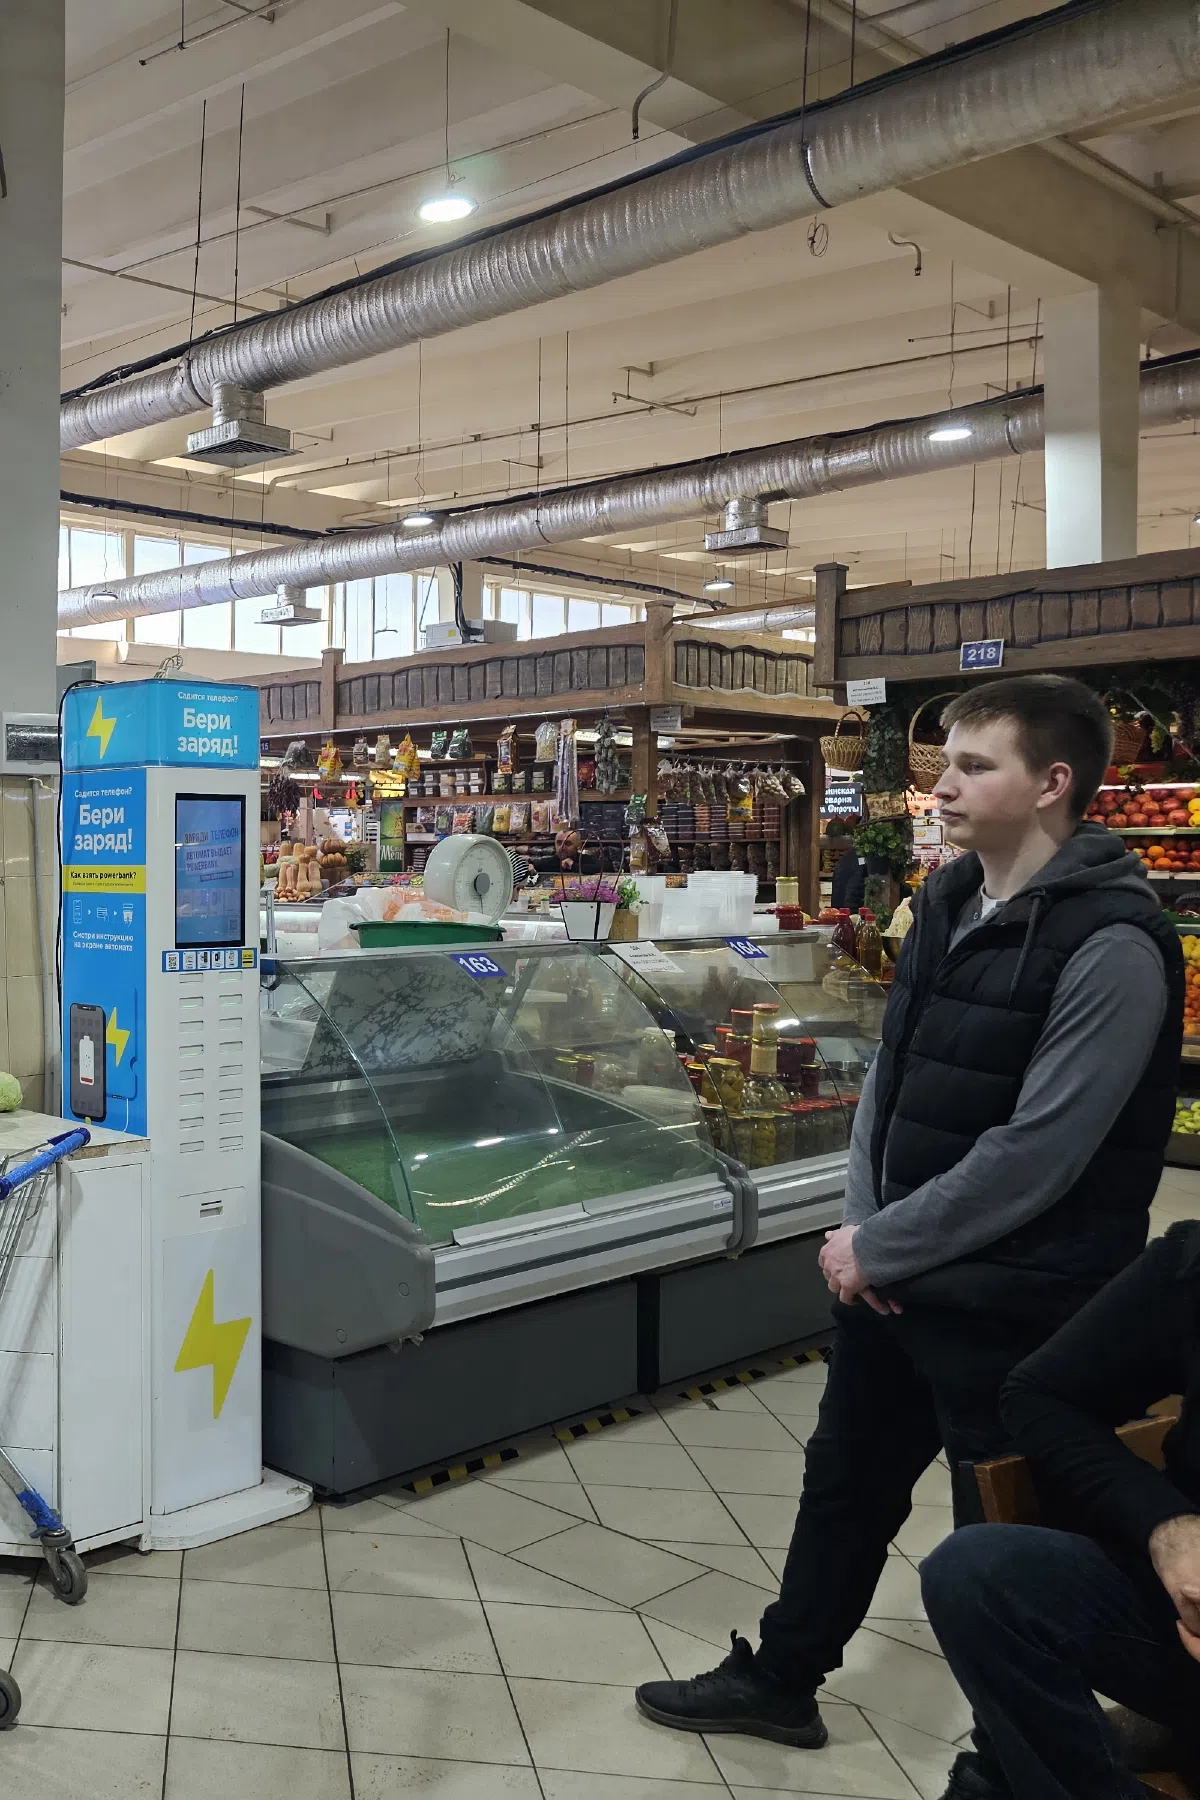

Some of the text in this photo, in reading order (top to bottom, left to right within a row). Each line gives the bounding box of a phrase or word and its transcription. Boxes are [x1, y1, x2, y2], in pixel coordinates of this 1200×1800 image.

[967, 647, 996, 661] 218
[178, 692, 239, 703] Садится телефон?
[183, 708, 231, 733] Бери
[177, 735, 239, 757] заряд!
[74, 787, 133, 798] Садится телефон?
[80, 804, 125, 829] Бери
[210, 828, 239, 840] ТЕЛЕФОН
[74, 828, 133, 855] заряд!
[186, 847, 232, 860] АВТОМАТ ВЫДАЕТ
[100, 872, 137, 880] powerbank?
[73, 931, 133, 942] Смотри инструкцию
[82, 942, 103, 950] экране
[105, 943, 133, 952] автомата
[730, 941, 762, 955] 164
[459, 956, 499, 973] 163
